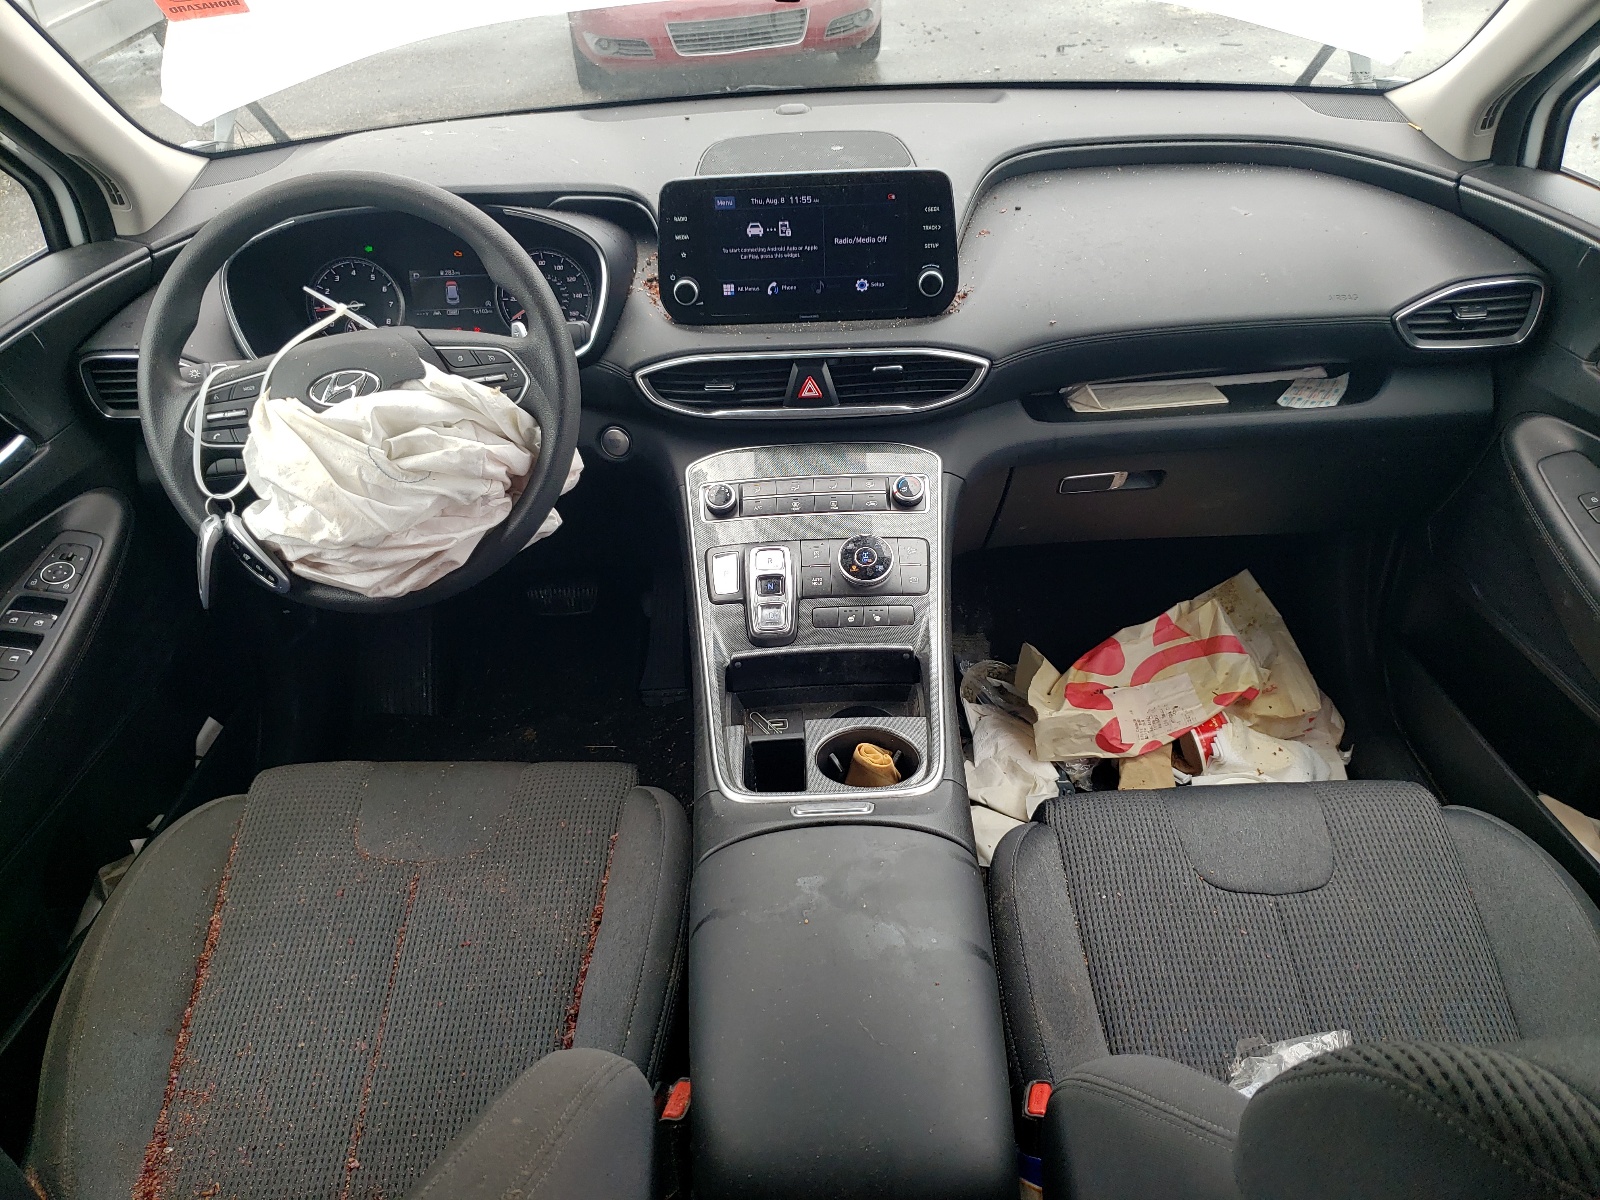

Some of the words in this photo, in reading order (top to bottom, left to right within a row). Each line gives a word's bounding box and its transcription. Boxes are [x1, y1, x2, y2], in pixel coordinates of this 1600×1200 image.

[750, 198, 765, 206] Thu,
[765, 197, 780, 206] Aug.
[789, 195, 812, 204] 11:55
[834, 236, 876, 245] Radio/Media
[876, 235, 888, 243] Off
[767, 582, 774, 590] N
